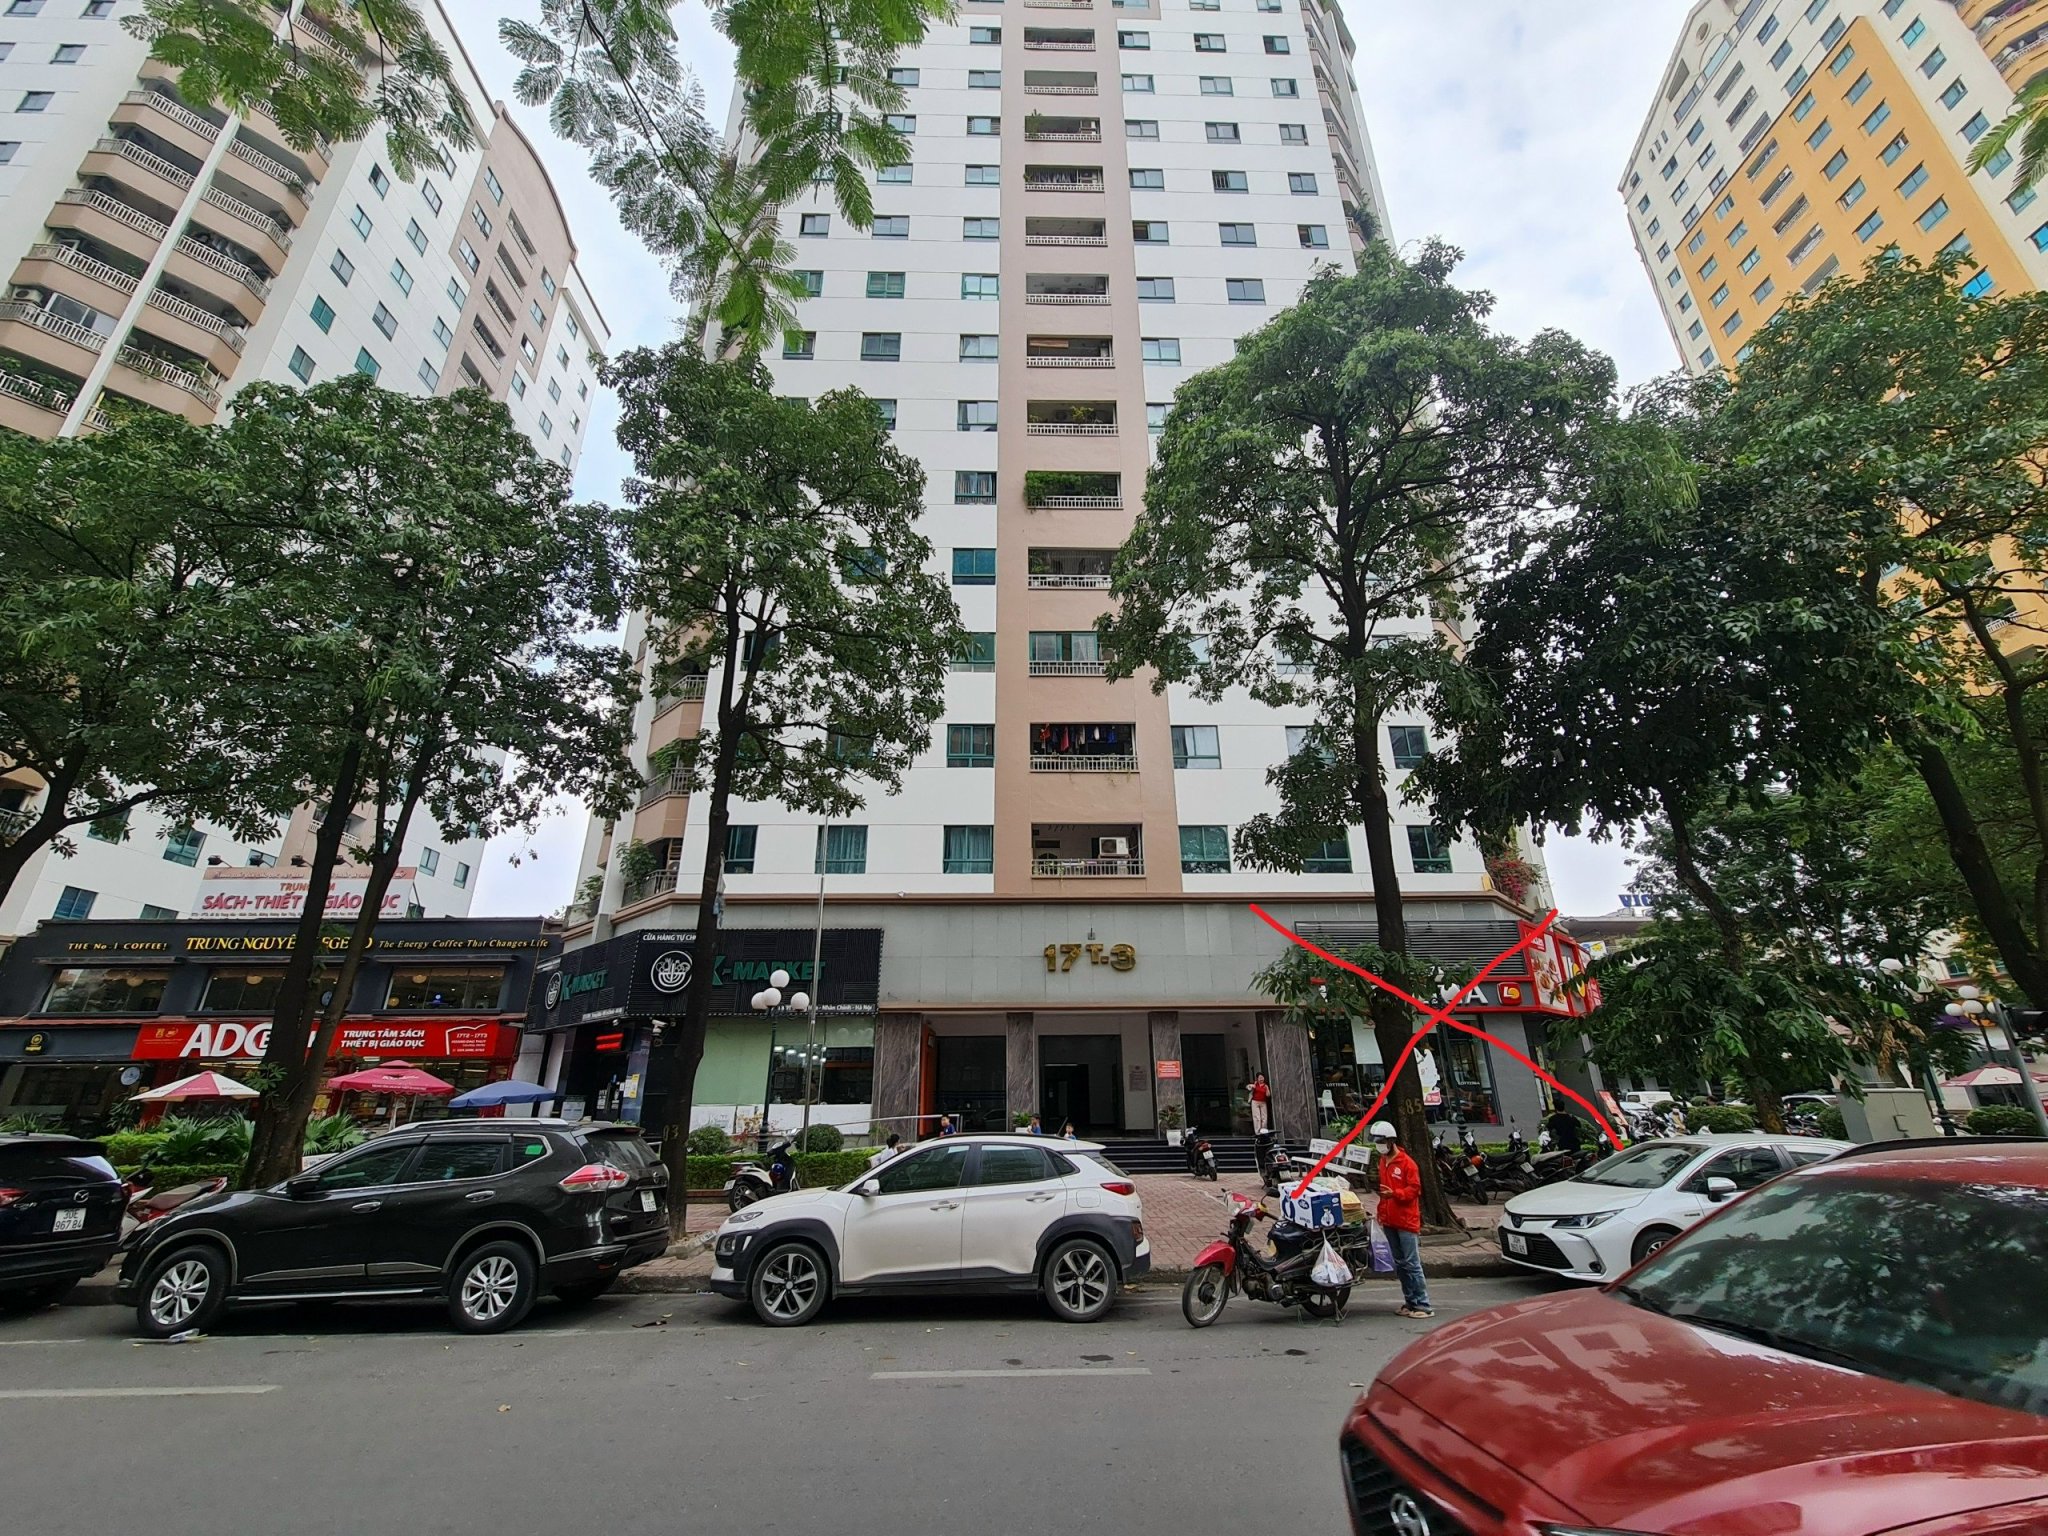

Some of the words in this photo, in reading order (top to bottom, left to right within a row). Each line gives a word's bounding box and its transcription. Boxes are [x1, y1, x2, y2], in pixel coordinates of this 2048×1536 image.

[186, 937, 239, 950] TRUNG
[379, 940, 393, 948] The
[398, 940, 428, 949] Energy
[432, 939, 463, 948] Coffee
[466, 939, 487, 948] That
[489, 939, 527, 949] Changes
[530, 938, 548, 948] Life
[377, 1028, 398, 1037] TÂM
[399, 1028, 425, 1037] SÁCH
[341, 1038, 368, 1047] THIẾT
[368, 1040, 379, 1049] BỊ
[380, 1038, 404, 1047] GIÁO
[404, 1040, 425, 1049] DỤC
